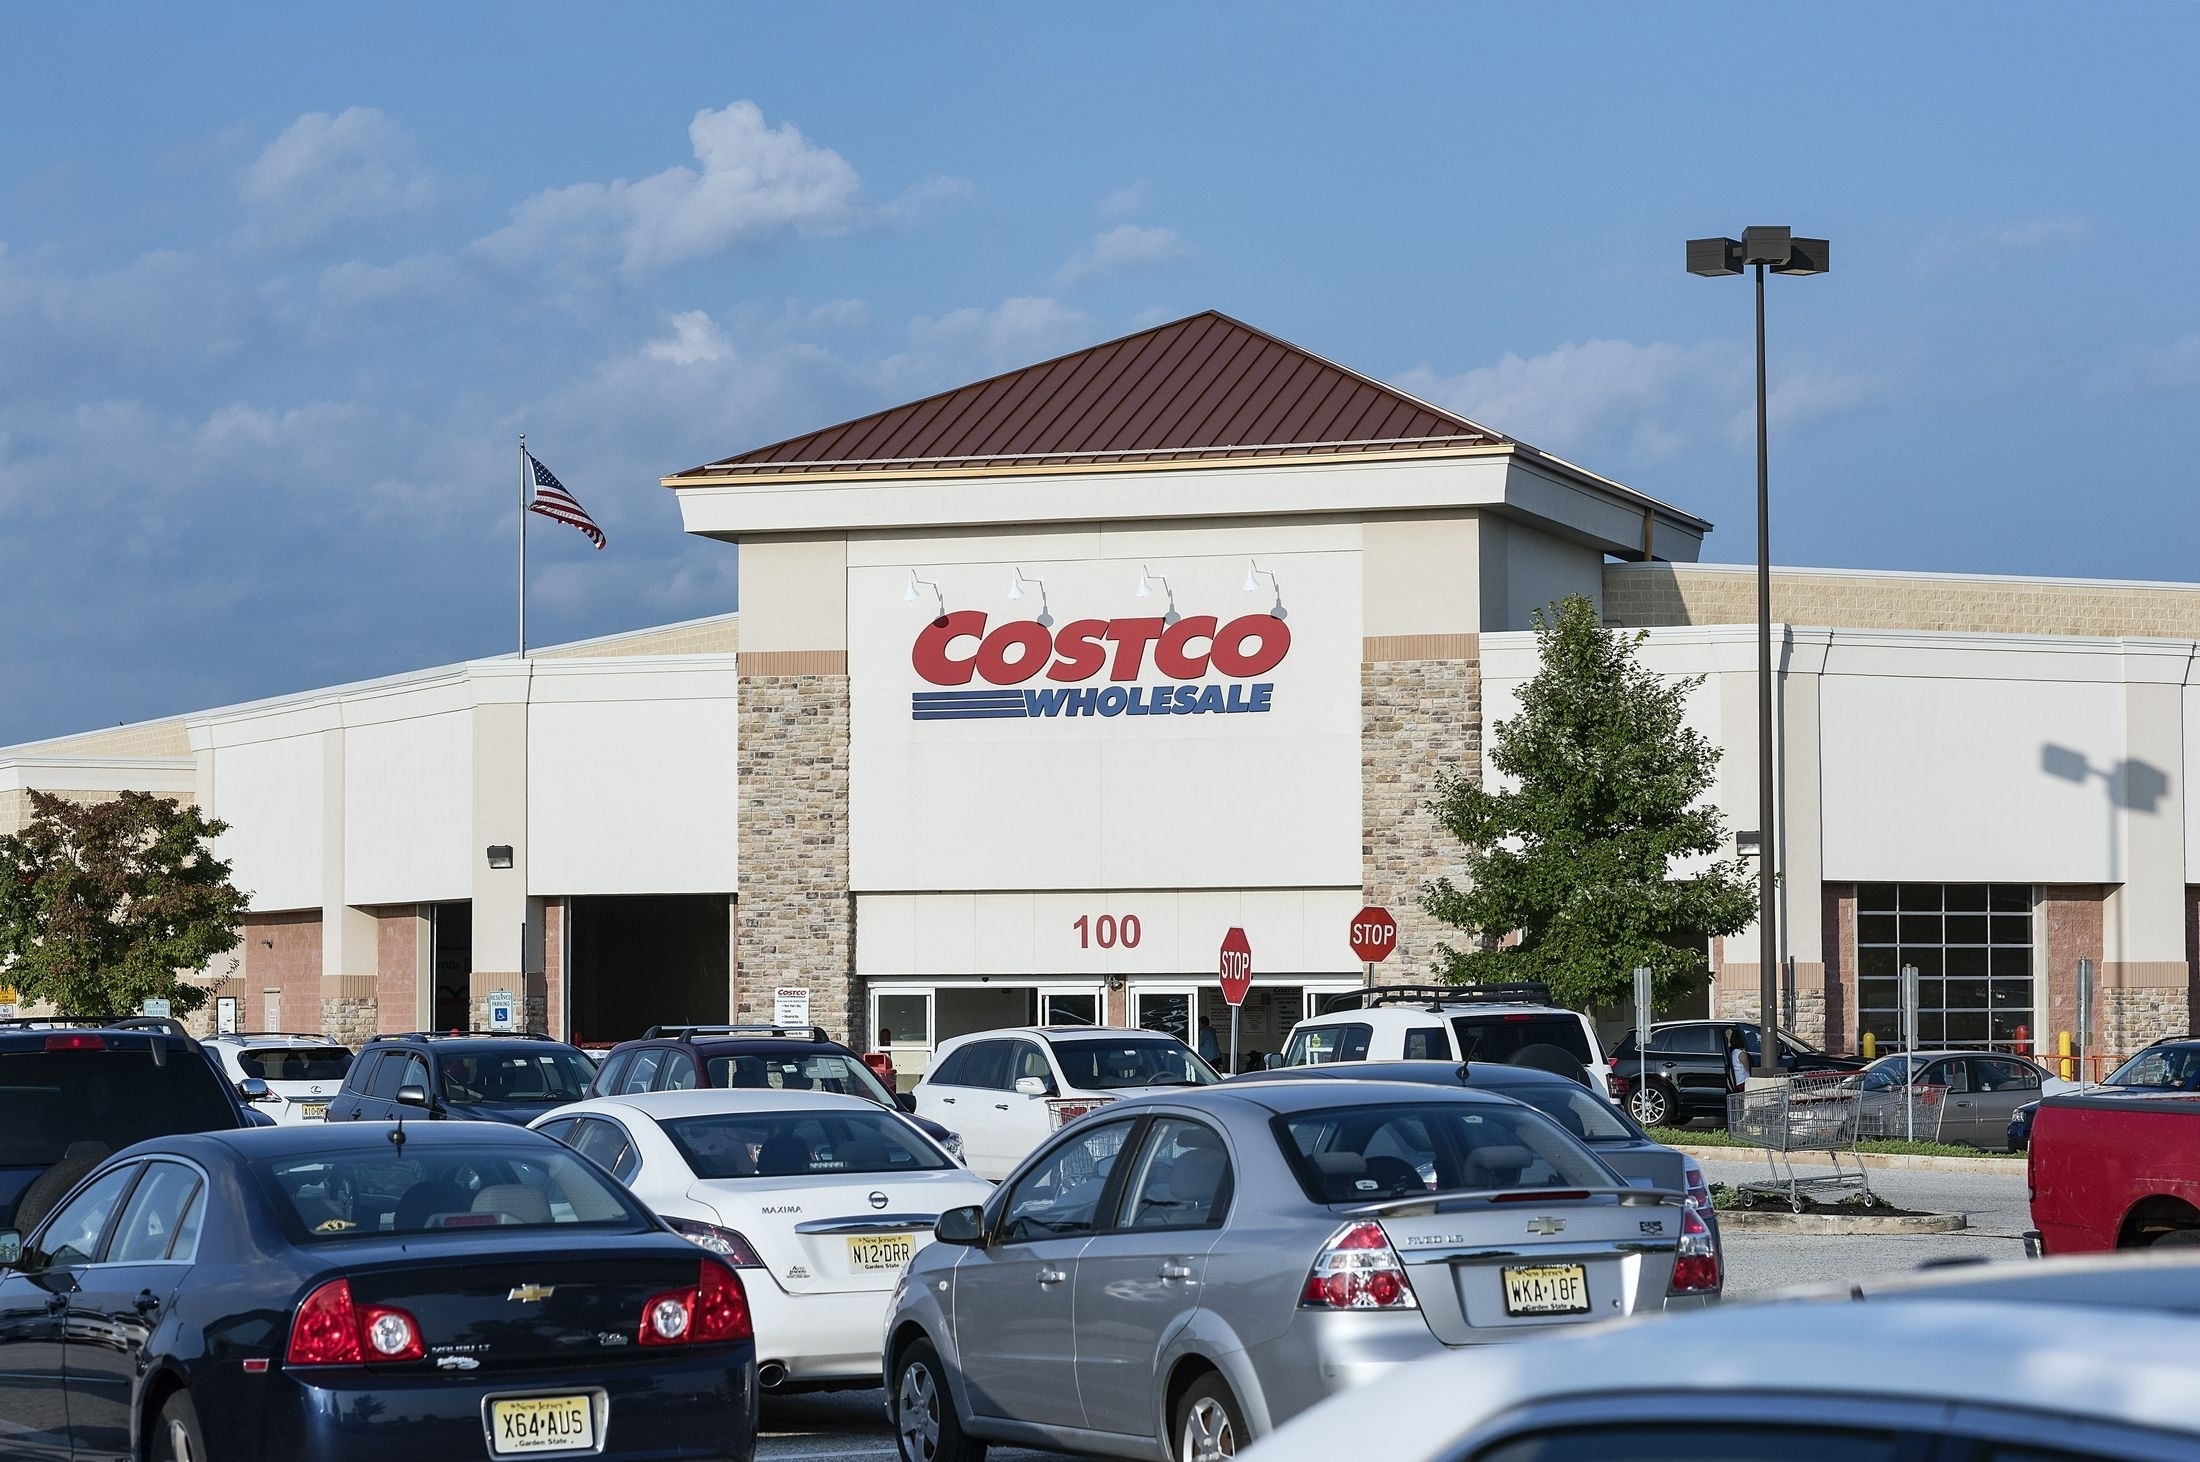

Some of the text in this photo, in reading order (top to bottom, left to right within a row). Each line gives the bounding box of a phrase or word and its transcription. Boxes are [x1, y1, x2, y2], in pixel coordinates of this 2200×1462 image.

[912, 610, 1291, 686] COSTCO
[1023, 683, 1274, 717] WHOLESALE
[1073, 915, 1141, 949] 100
[1353, 923, 1394, 945] STOP
[1221, 950, 1249, 980] STOP
[762, 1206, 802, 1214] MAXIMA
[878, 1236, 896, 1244] Jersey
[1542, 1269, 1564, 1278] Jersey
[516, 1402, 564, 1412] New Jersey
